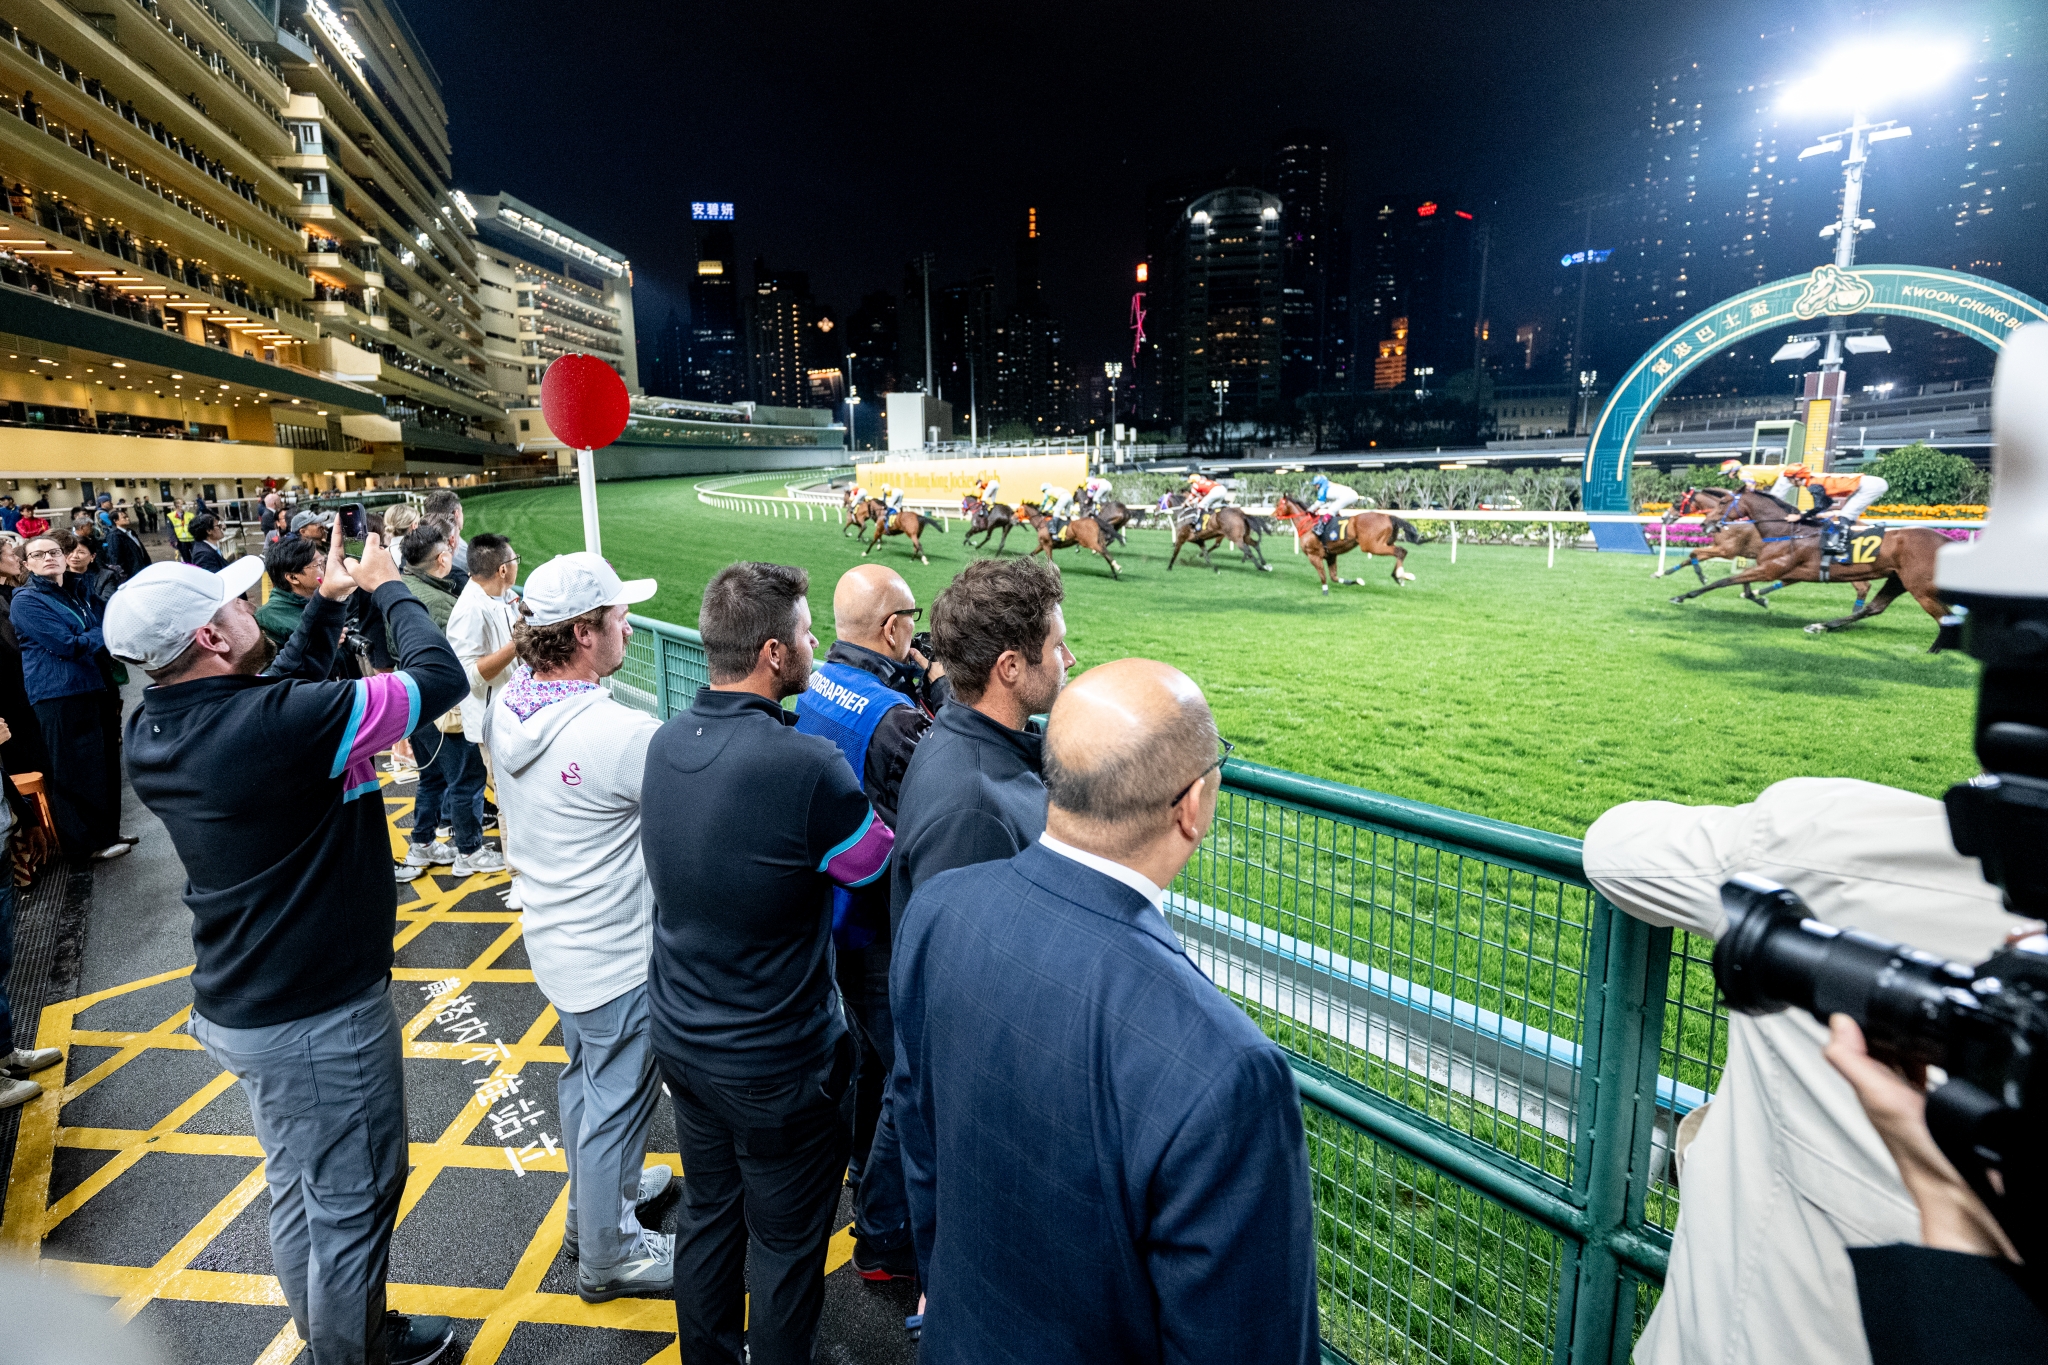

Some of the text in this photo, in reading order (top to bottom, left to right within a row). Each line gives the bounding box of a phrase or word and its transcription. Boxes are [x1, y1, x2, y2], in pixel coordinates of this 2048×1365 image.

[1901, 285, 2028, 332] KWOON CHUNG BU
[1651, 299, 1770, 377] 冠忠巴士盃
[914, 473, 930, 493] Hong
[930, 471, 948, 493] Kong
[1338, 519, 1349, 540] 7
[1850, 535, 1882, 564] 12
[809, 671, 869, 715] TOGRAPHER
